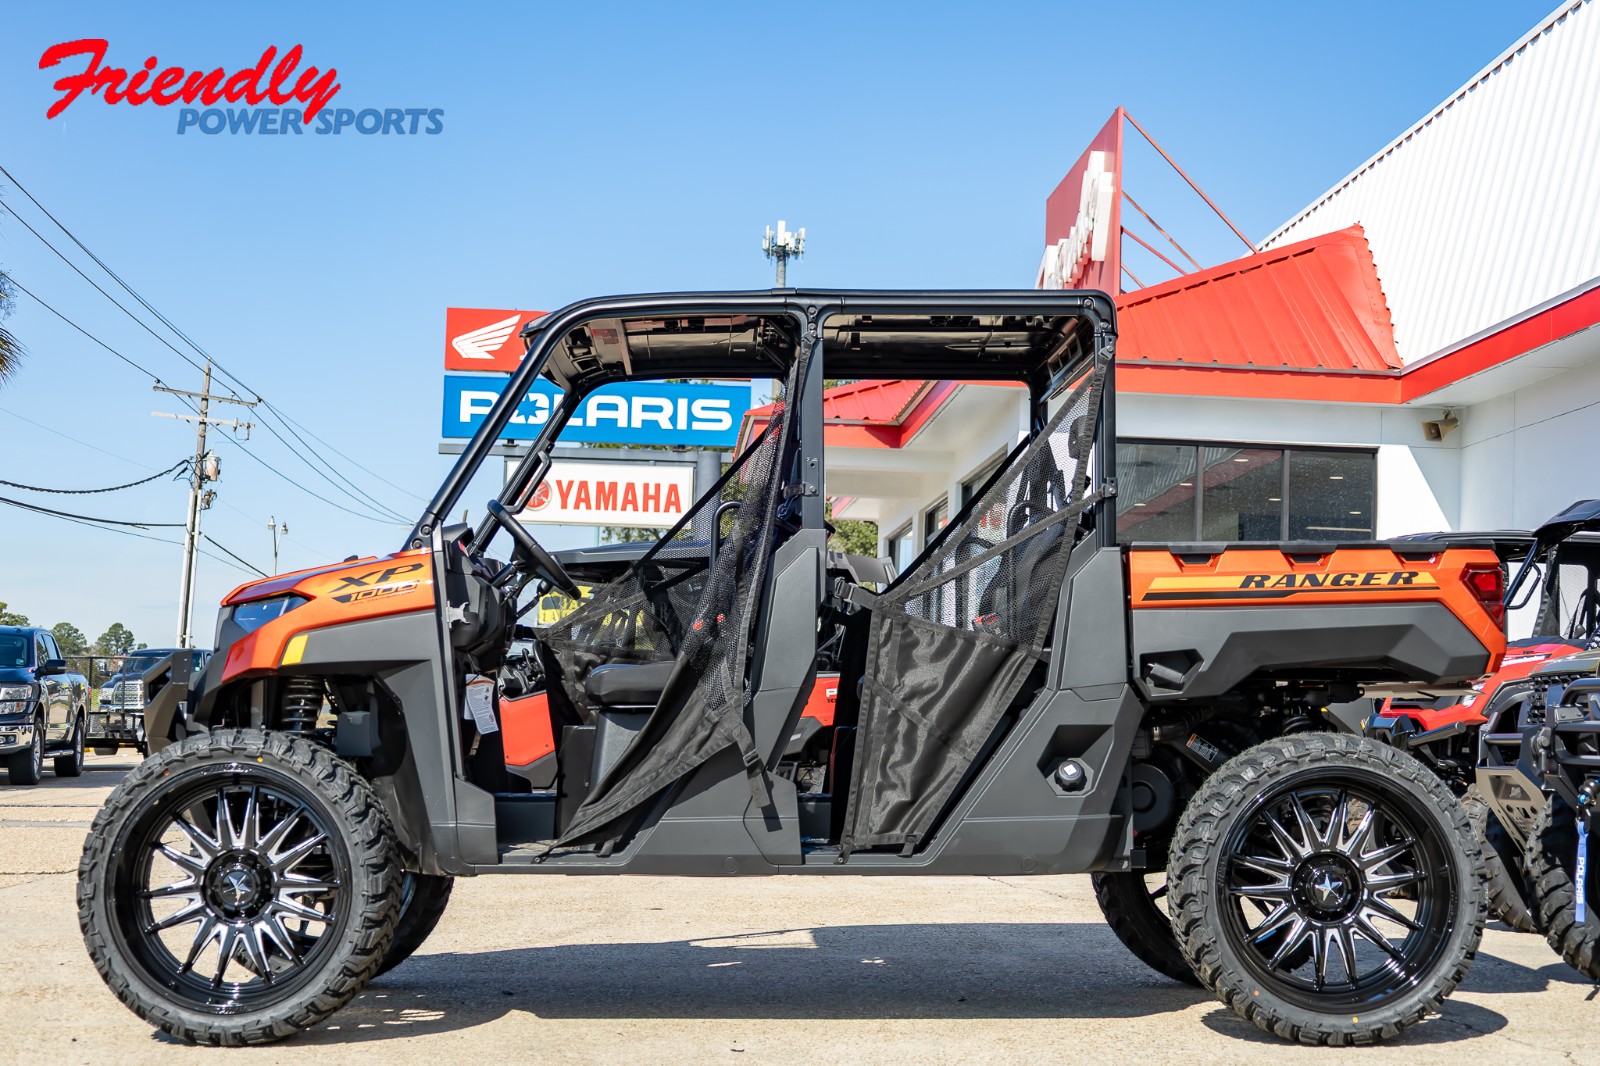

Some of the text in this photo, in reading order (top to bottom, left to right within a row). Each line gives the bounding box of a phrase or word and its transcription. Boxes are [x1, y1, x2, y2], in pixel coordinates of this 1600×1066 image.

[556, 479, 682, 513] YAMAHA
[328, 563, 424, 594] XP
[1238, 571, 1420, 589] RANGER
[1575, 856, 1585, 905] POLARIS
